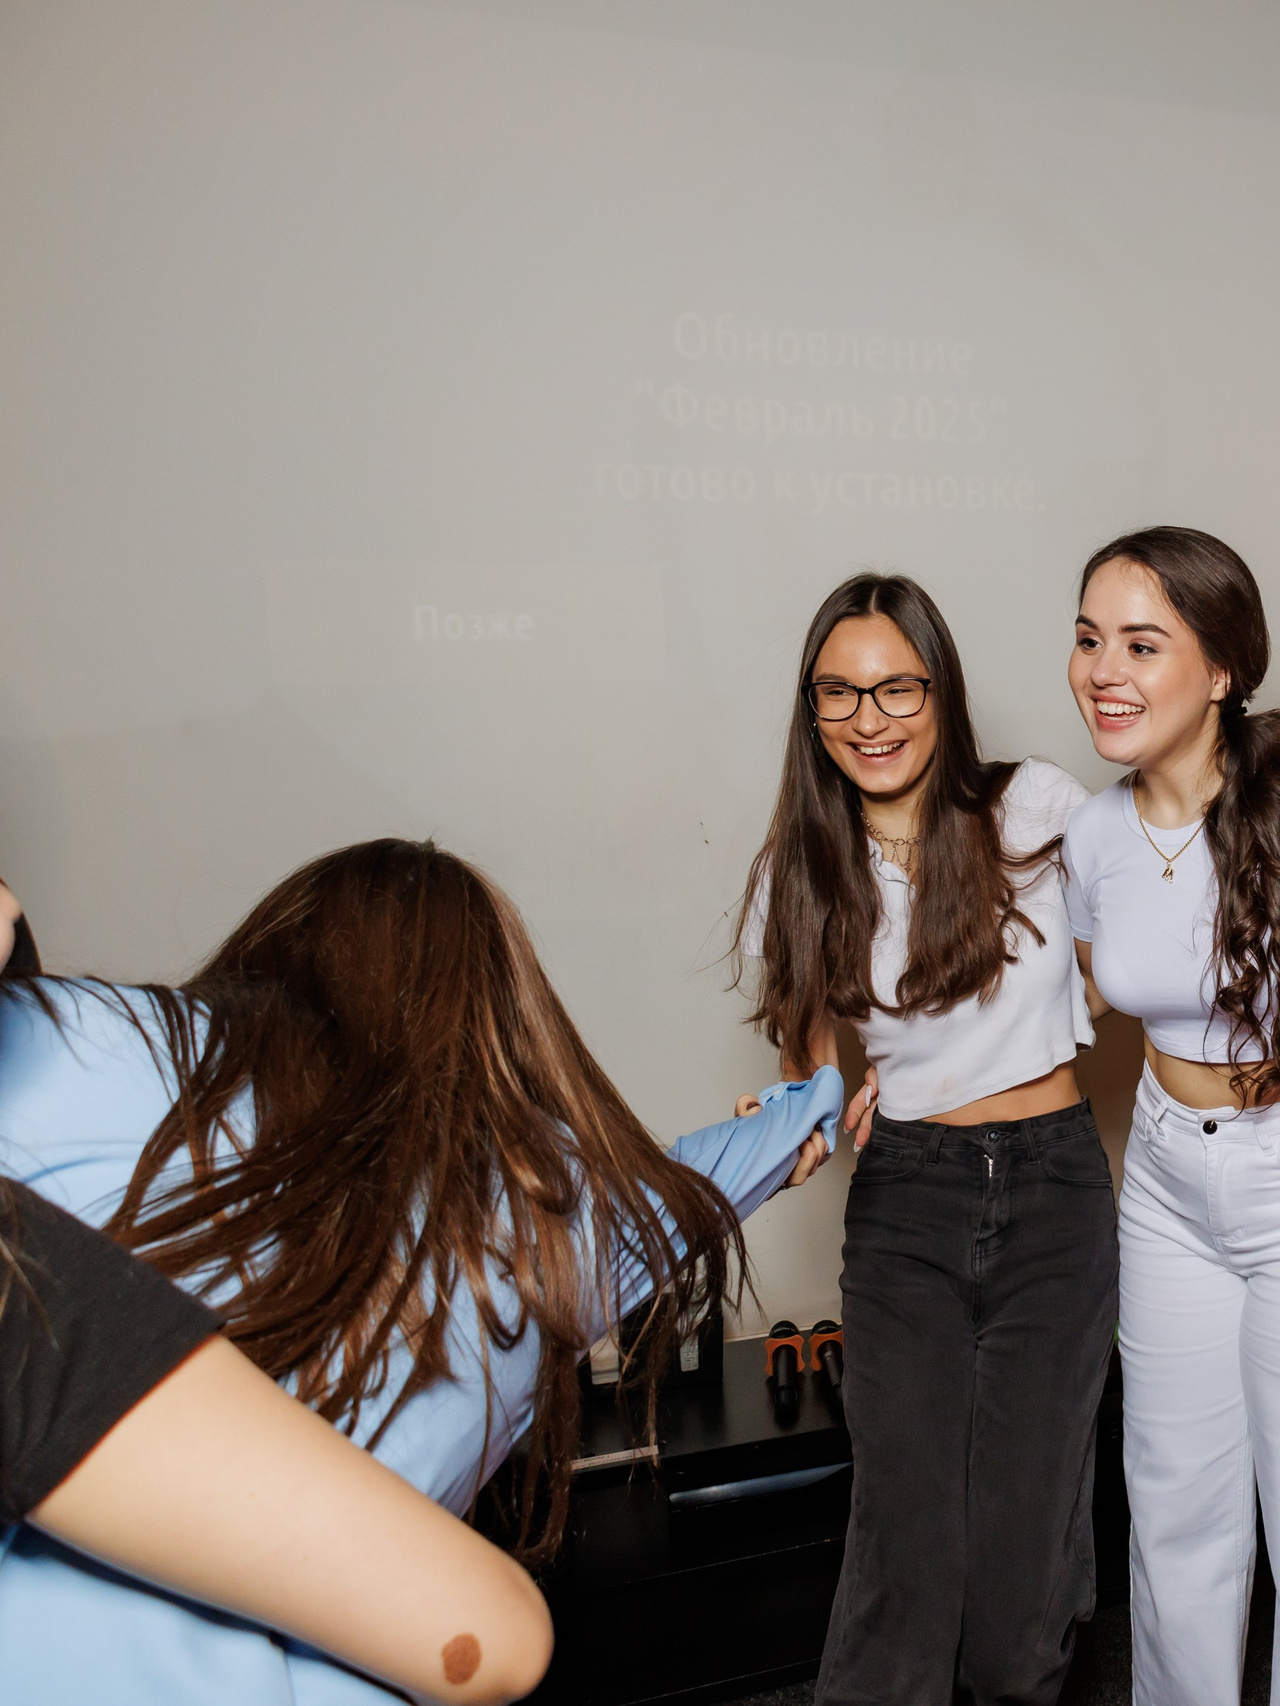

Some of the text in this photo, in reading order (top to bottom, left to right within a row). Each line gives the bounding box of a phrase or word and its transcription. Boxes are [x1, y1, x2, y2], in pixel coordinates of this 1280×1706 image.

[673, 311, 973, 376] Обновление
[636, 378, 1008, 444] "Февраль 2025"
[595, 462, 756, 503] готово
[774, 470, 798, 505] к
[413, 605, 534, 641] Позже
